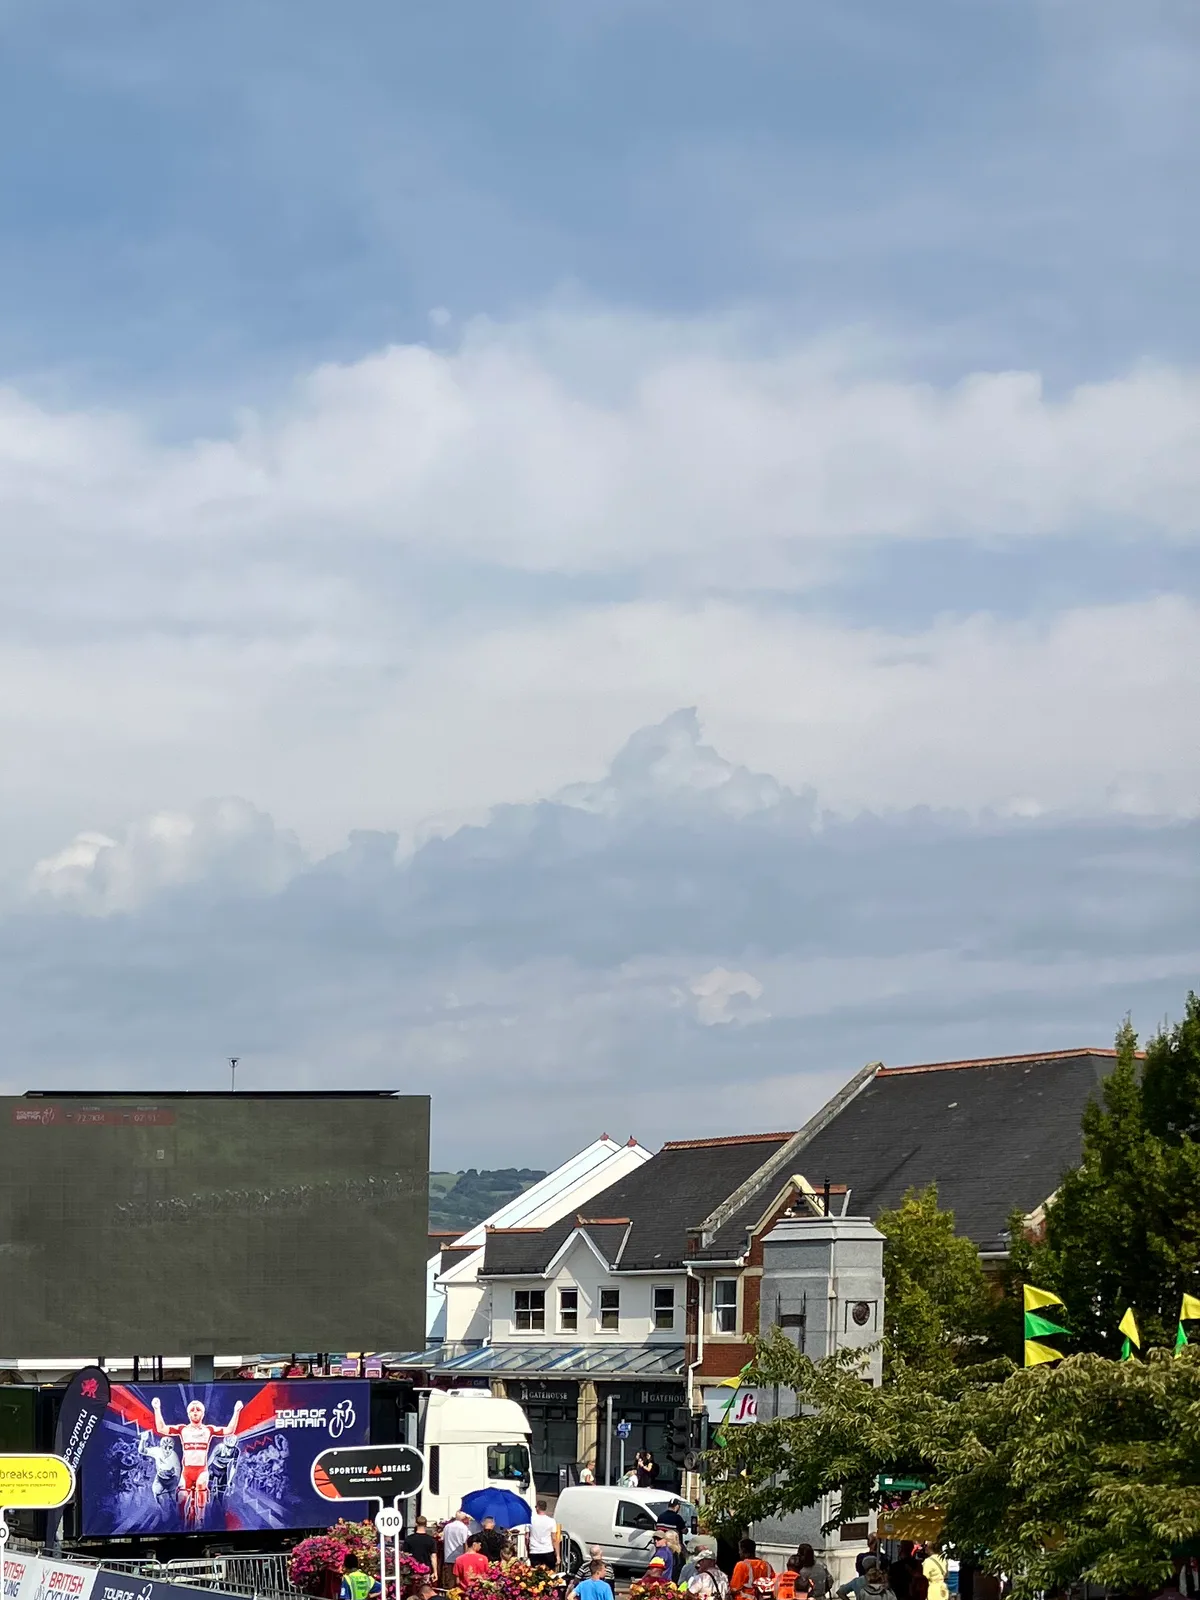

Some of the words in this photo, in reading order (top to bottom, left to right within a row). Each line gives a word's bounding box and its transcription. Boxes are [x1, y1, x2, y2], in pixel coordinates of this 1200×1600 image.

[529, 1391, 568, 1400] GATEHOUSE
[649, 1393, 686, 1403] GATEHOU
[275, 1409, 309, 1419] TOUR
[309, 1408, 327, 1418] OF
[275, 1417, 327, 1429] BRITAIN
[329, 1466, 368, 1475] SPORTIVE
[382, 1464, 411, 1473] BREAKS
[381, 1516, 400, 1527] 100
[49, 1571, 85, 1594] BRITISH
[104, 1587, 124, 1600] TOUR
[123, 1591, 135, 1600] OF
